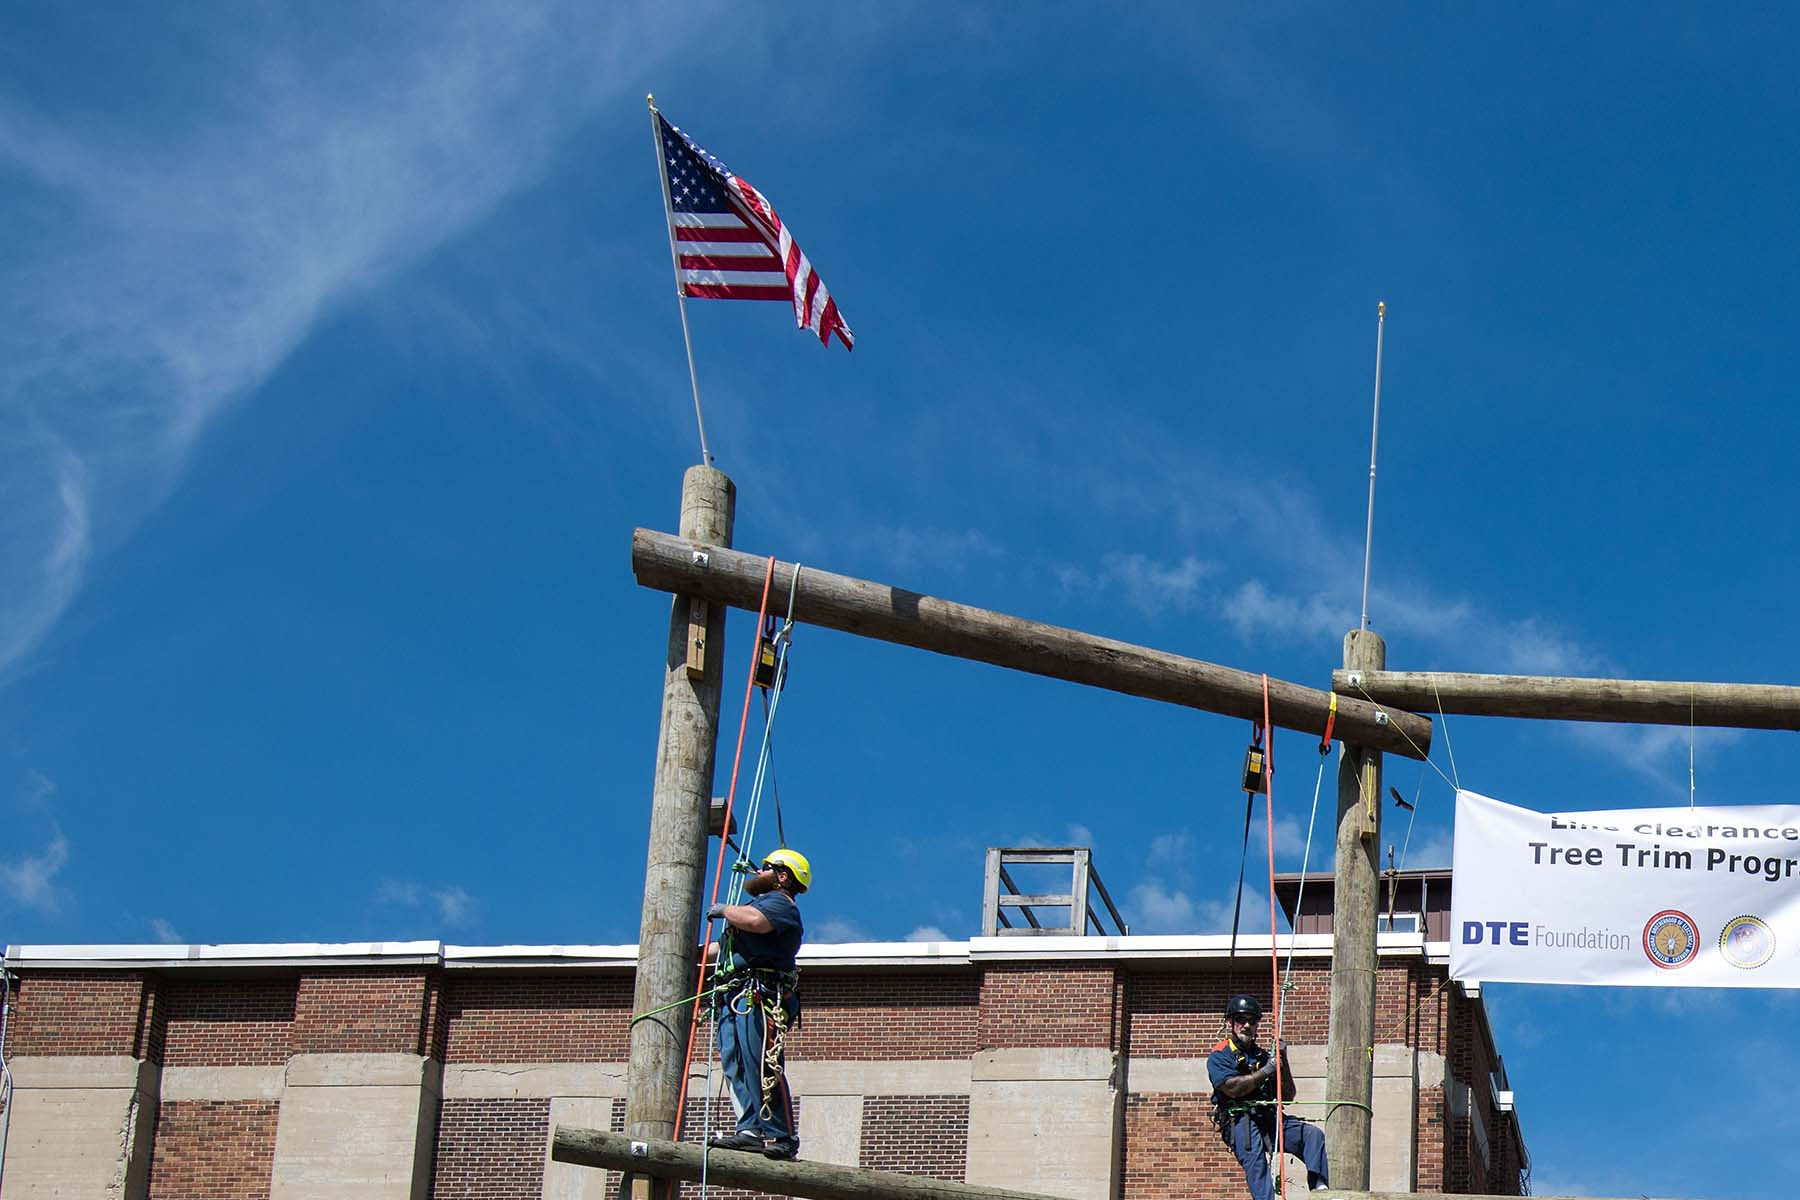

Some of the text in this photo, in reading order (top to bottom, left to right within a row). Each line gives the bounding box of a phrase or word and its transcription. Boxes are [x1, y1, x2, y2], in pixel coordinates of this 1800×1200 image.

[1529, 842, 1603, 866] Tree
[1616, 844, 1692, 870] Trim
[1462, 921, 1630, 951] DTE Foundation
